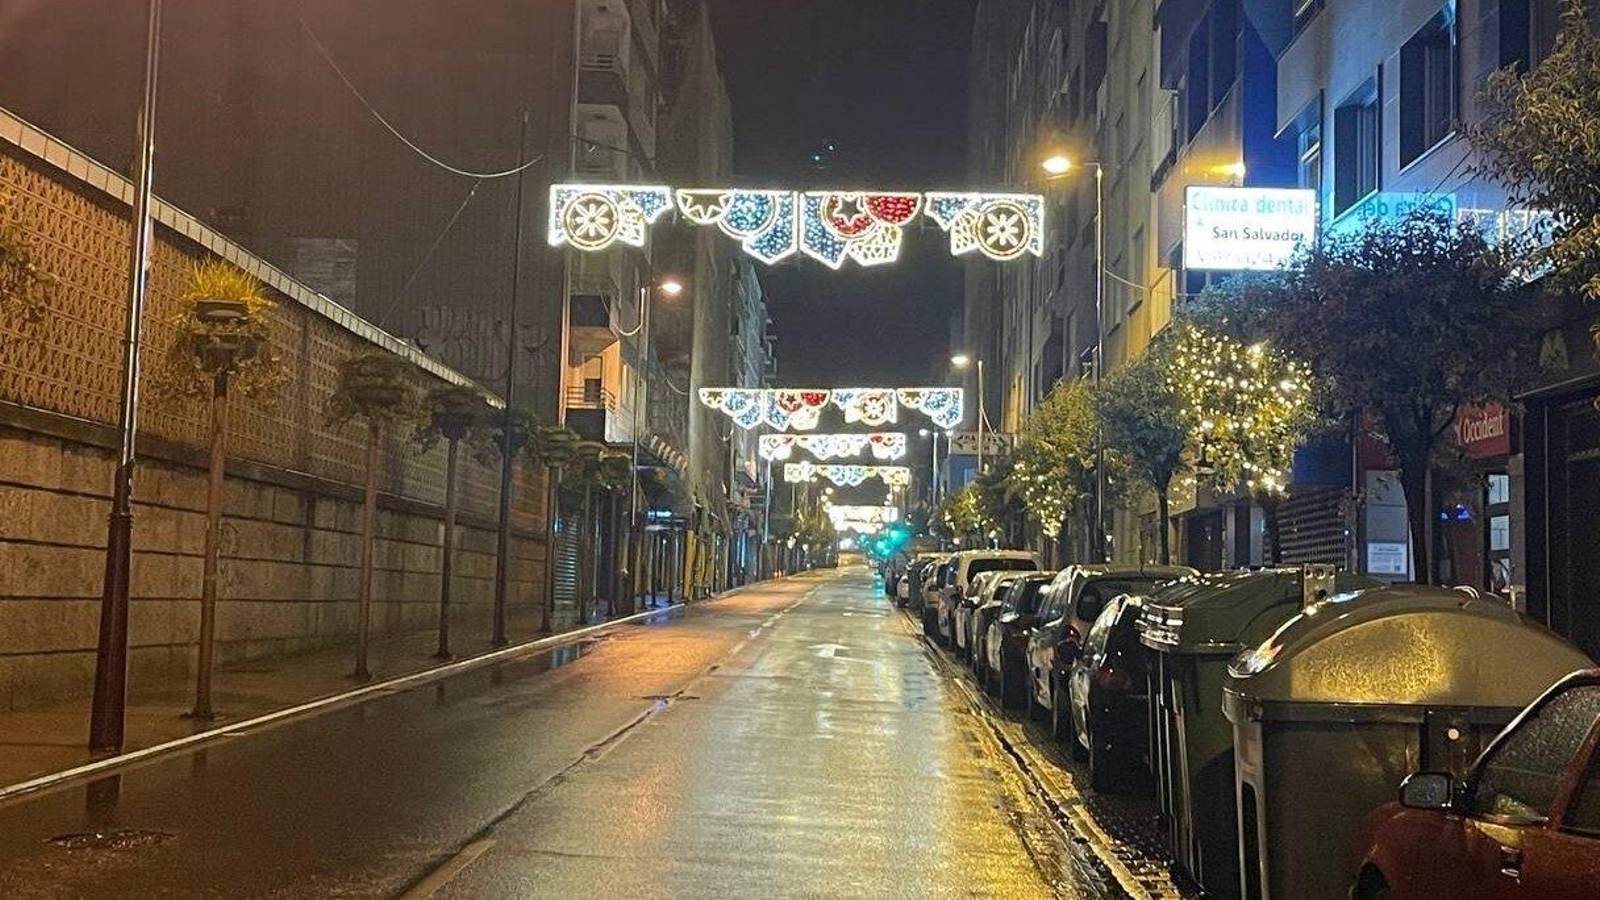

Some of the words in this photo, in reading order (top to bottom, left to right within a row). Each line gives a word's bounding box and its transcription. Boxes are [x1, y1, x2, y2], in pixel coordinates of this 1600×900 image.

[1212, 226, 1239, 239] San
[1242, 226, 1305, 241] Salvador
[1463, 411, 1504, 443] Occident
